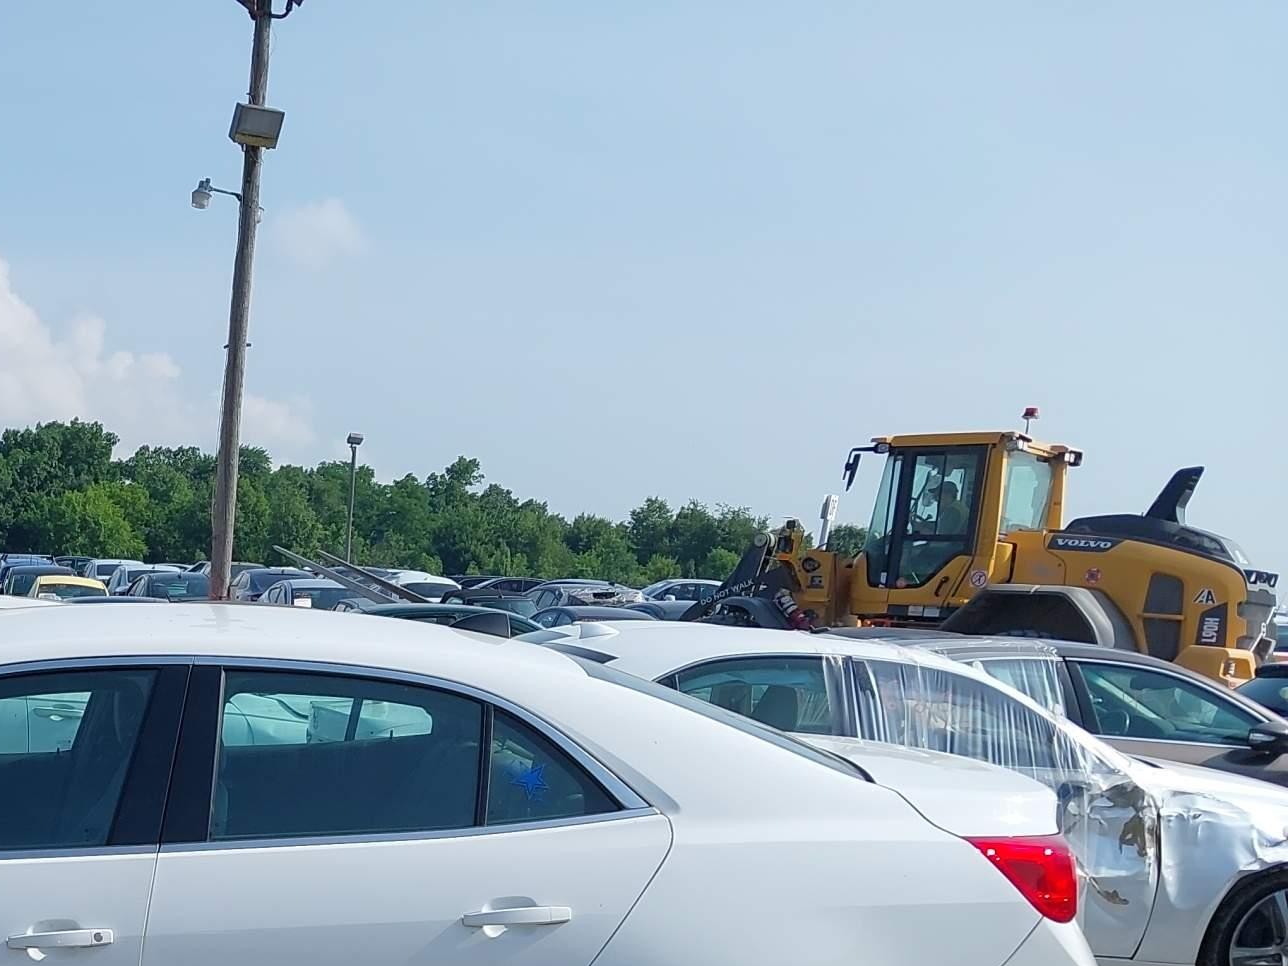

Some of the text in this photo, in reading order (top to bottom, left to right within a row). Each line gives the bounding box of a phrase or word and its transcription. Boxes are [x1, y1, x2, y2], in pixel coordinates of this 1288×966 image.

[1056, 538, 1112, 549] VOLVO
[700, 578, 754, 606] DO NOT WALK
[1201, 617, 1220, 643] L90H
